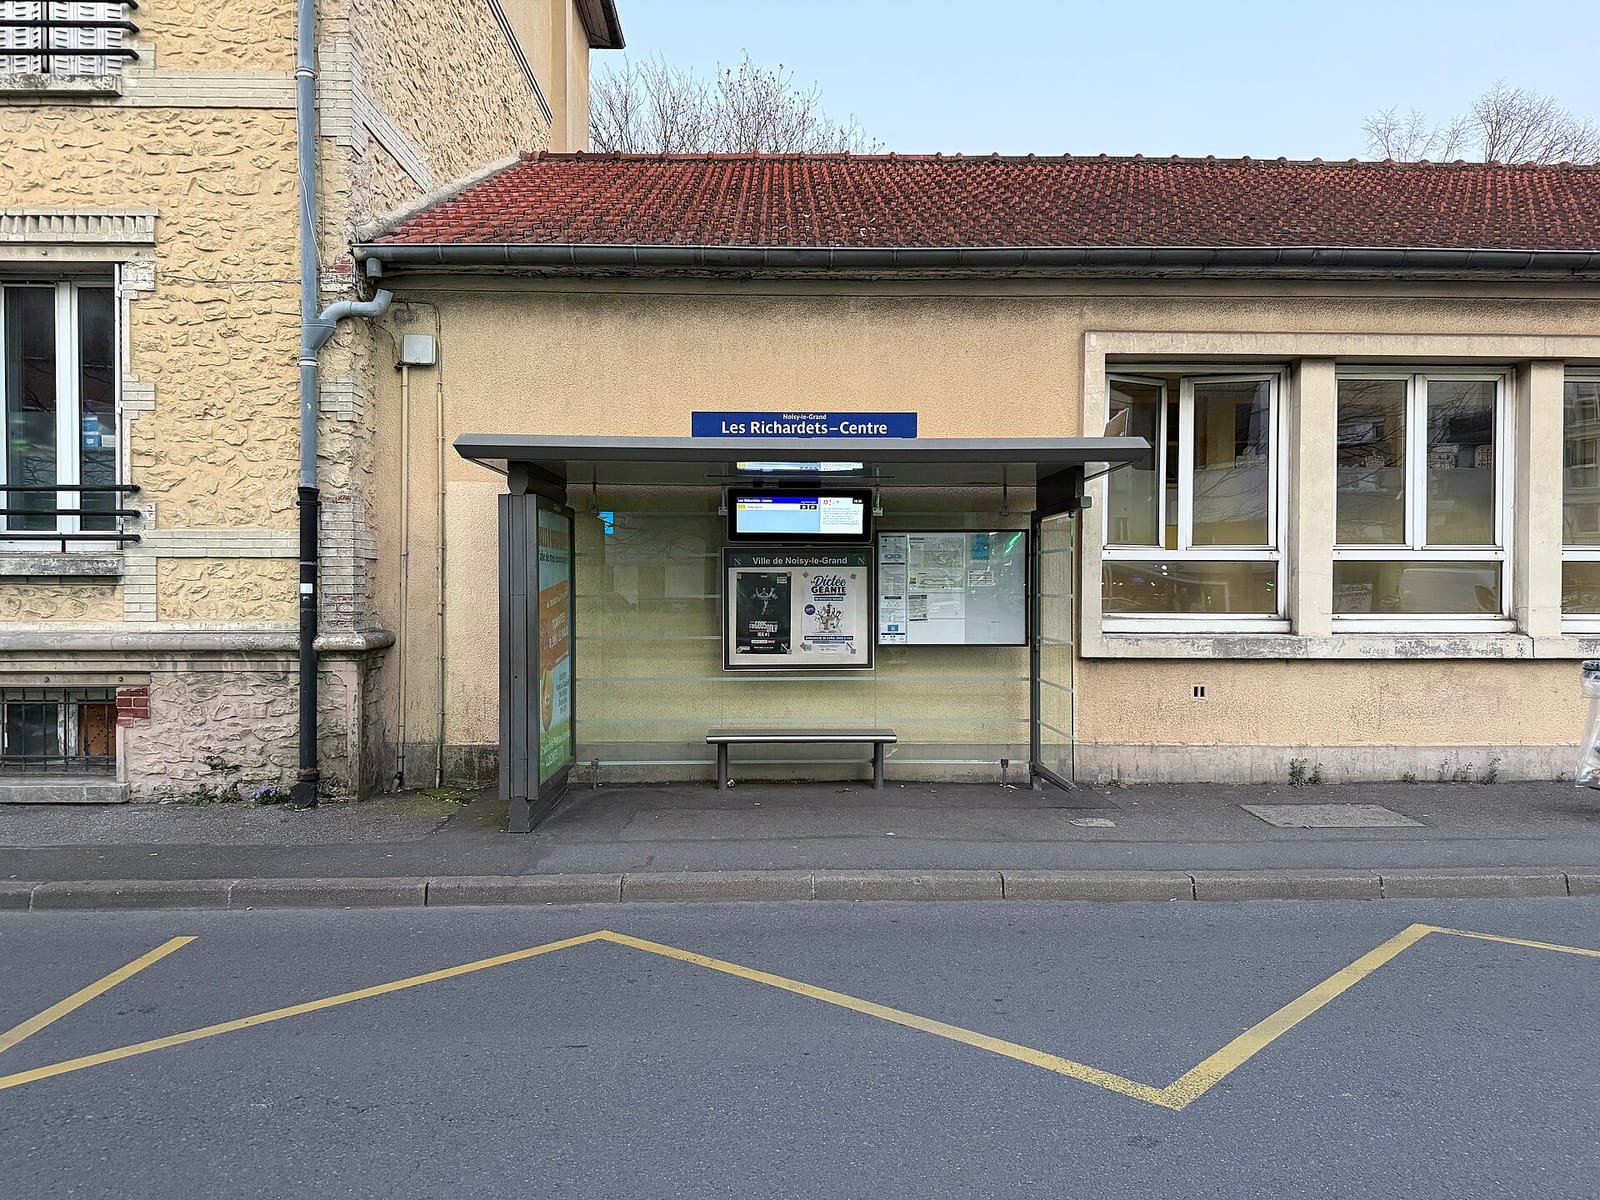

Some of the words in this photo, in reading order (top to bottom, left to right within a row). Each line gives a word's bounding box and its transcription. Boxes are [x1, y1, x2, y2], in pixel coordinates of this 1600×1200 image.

[722, 421, 746, 434] Les
[752, 557, 771, 565] Ville
[772, 557, 783, 565] de
[785, 557, 848, 566] Noisy-le-Grand
[813, 574, 847, 587] Dictée
